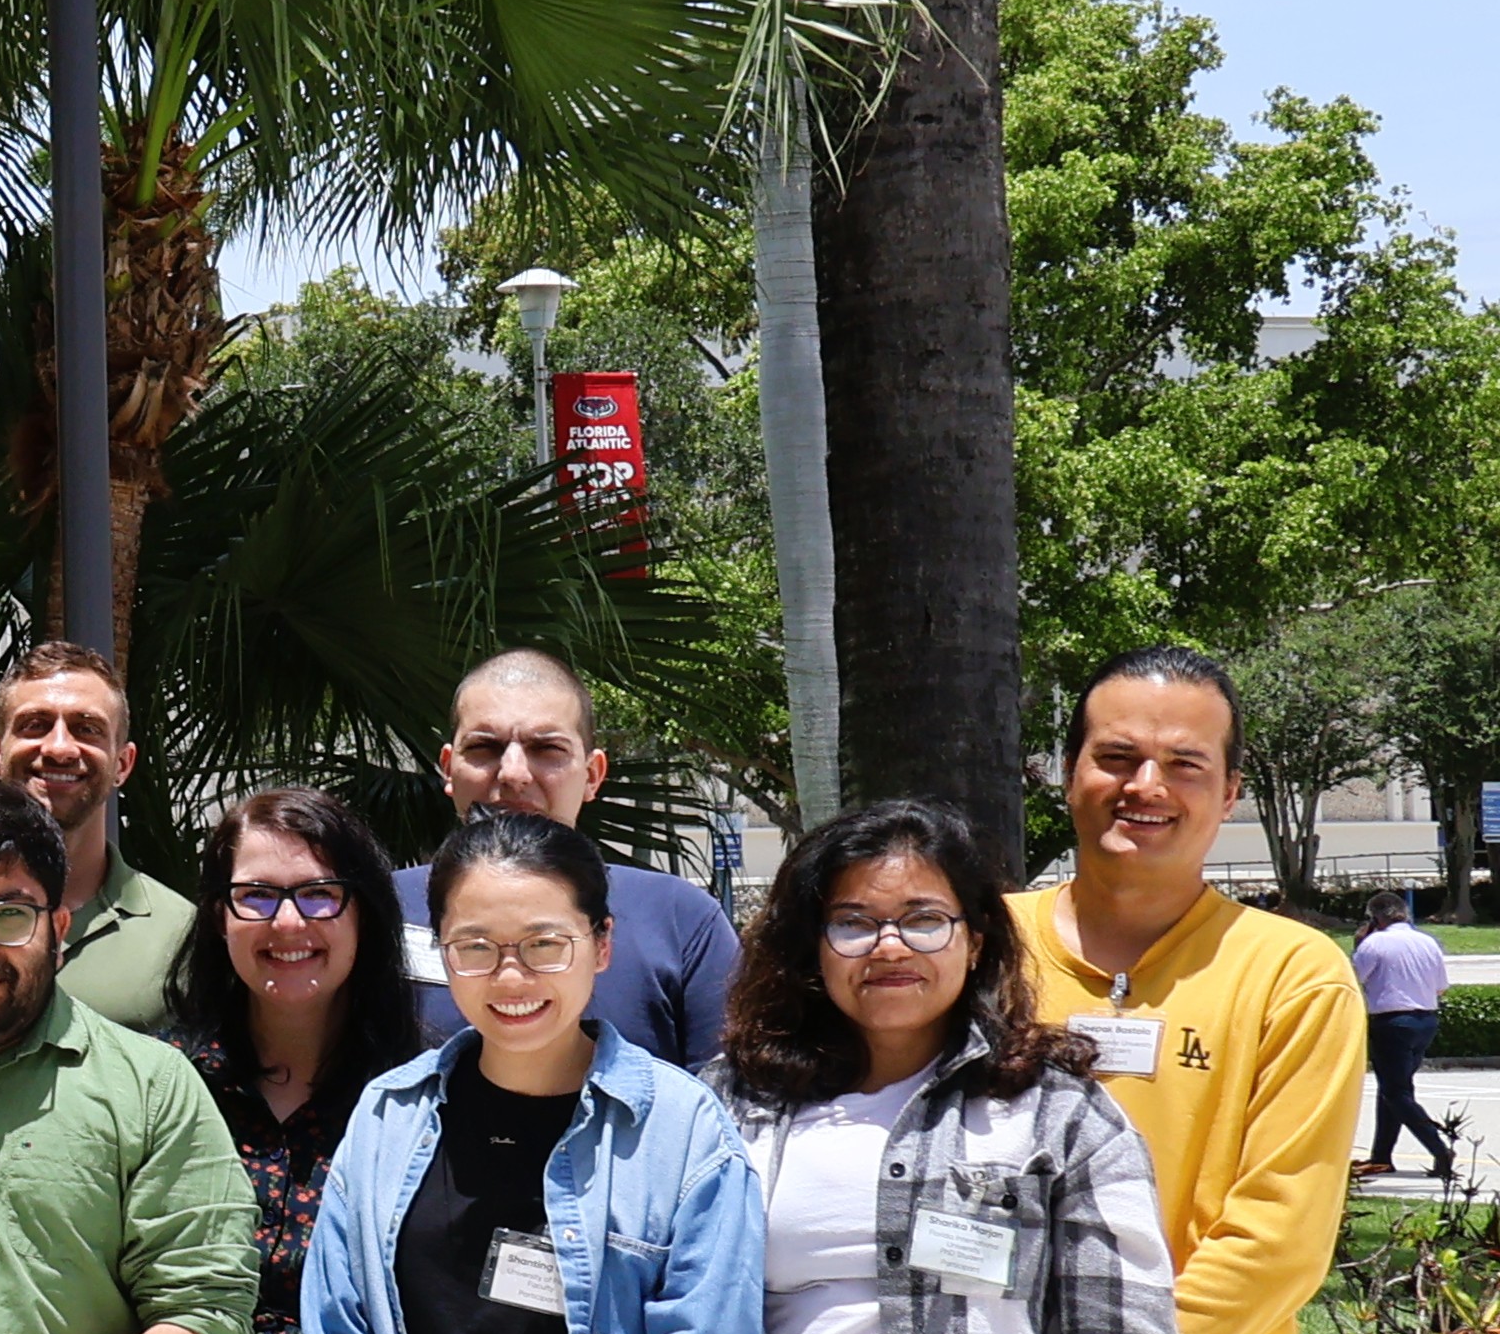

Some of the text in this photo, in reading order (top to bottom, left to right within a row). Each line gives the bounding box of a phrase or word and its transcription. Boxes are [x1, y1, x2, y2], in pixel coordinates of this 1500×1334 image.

[570, 426, 627, 438] FLORIDA
[566, 438, 632, 451] ATLANTIC
[567, 461, 635, 489] TOP
[1177, 1027, 1210, 1070] LA
